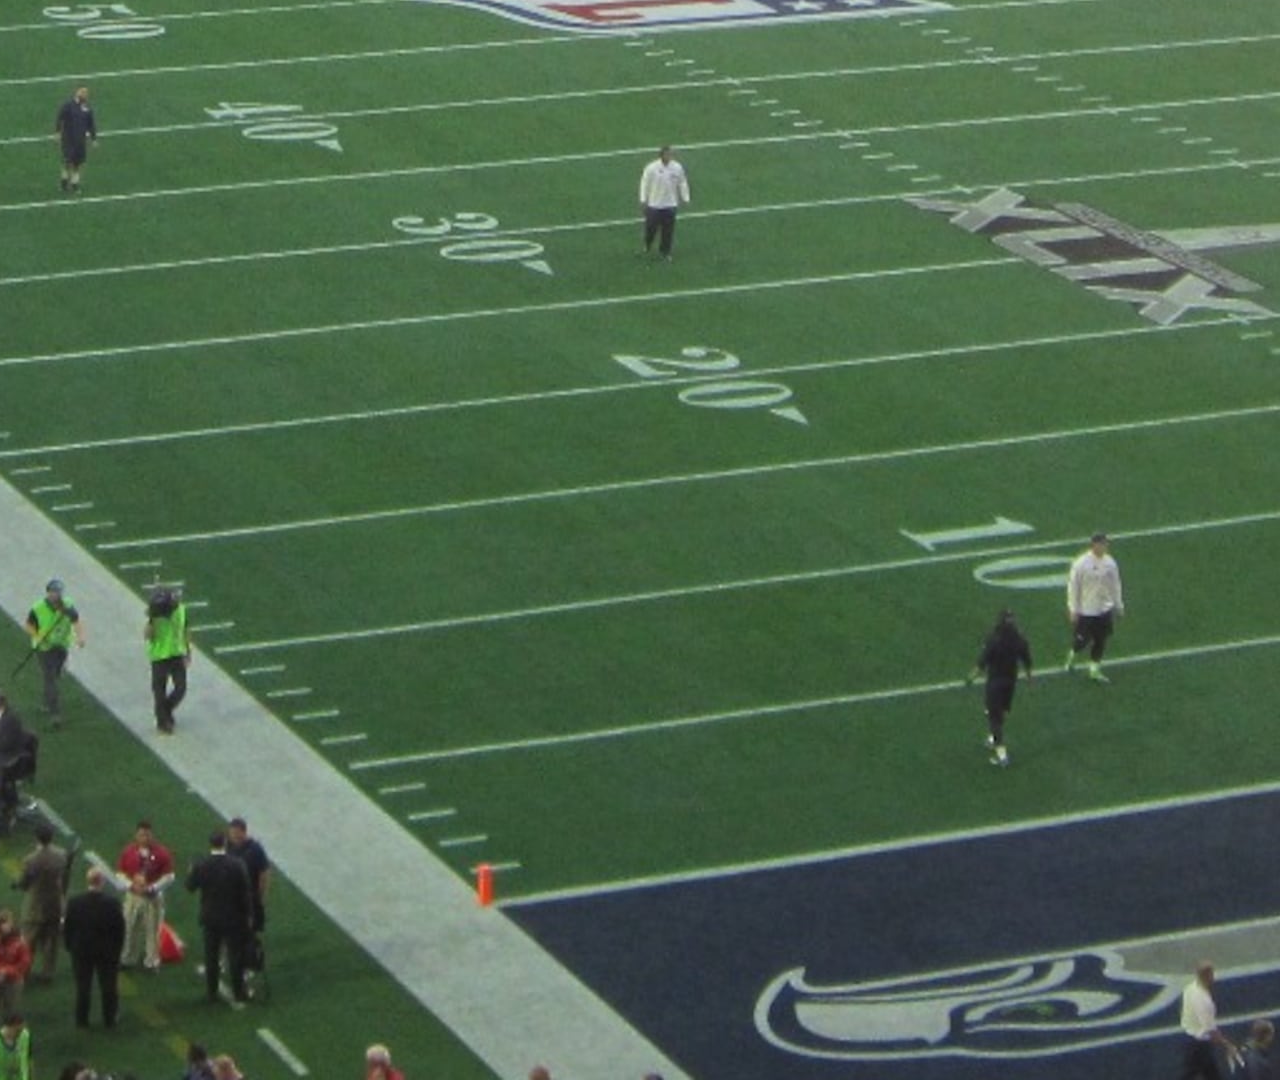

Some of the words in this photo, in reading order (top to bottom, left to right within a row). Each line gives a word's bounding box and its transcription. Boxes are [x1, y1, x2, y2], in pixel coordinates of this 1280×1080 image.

[42, 3, 167, 41] 50
[203, 101, 340, 142] 40
[391, 211, 546, 264] 30
[611, 346, 794, 410] 20
[898, 516, 1072, 590] 10
